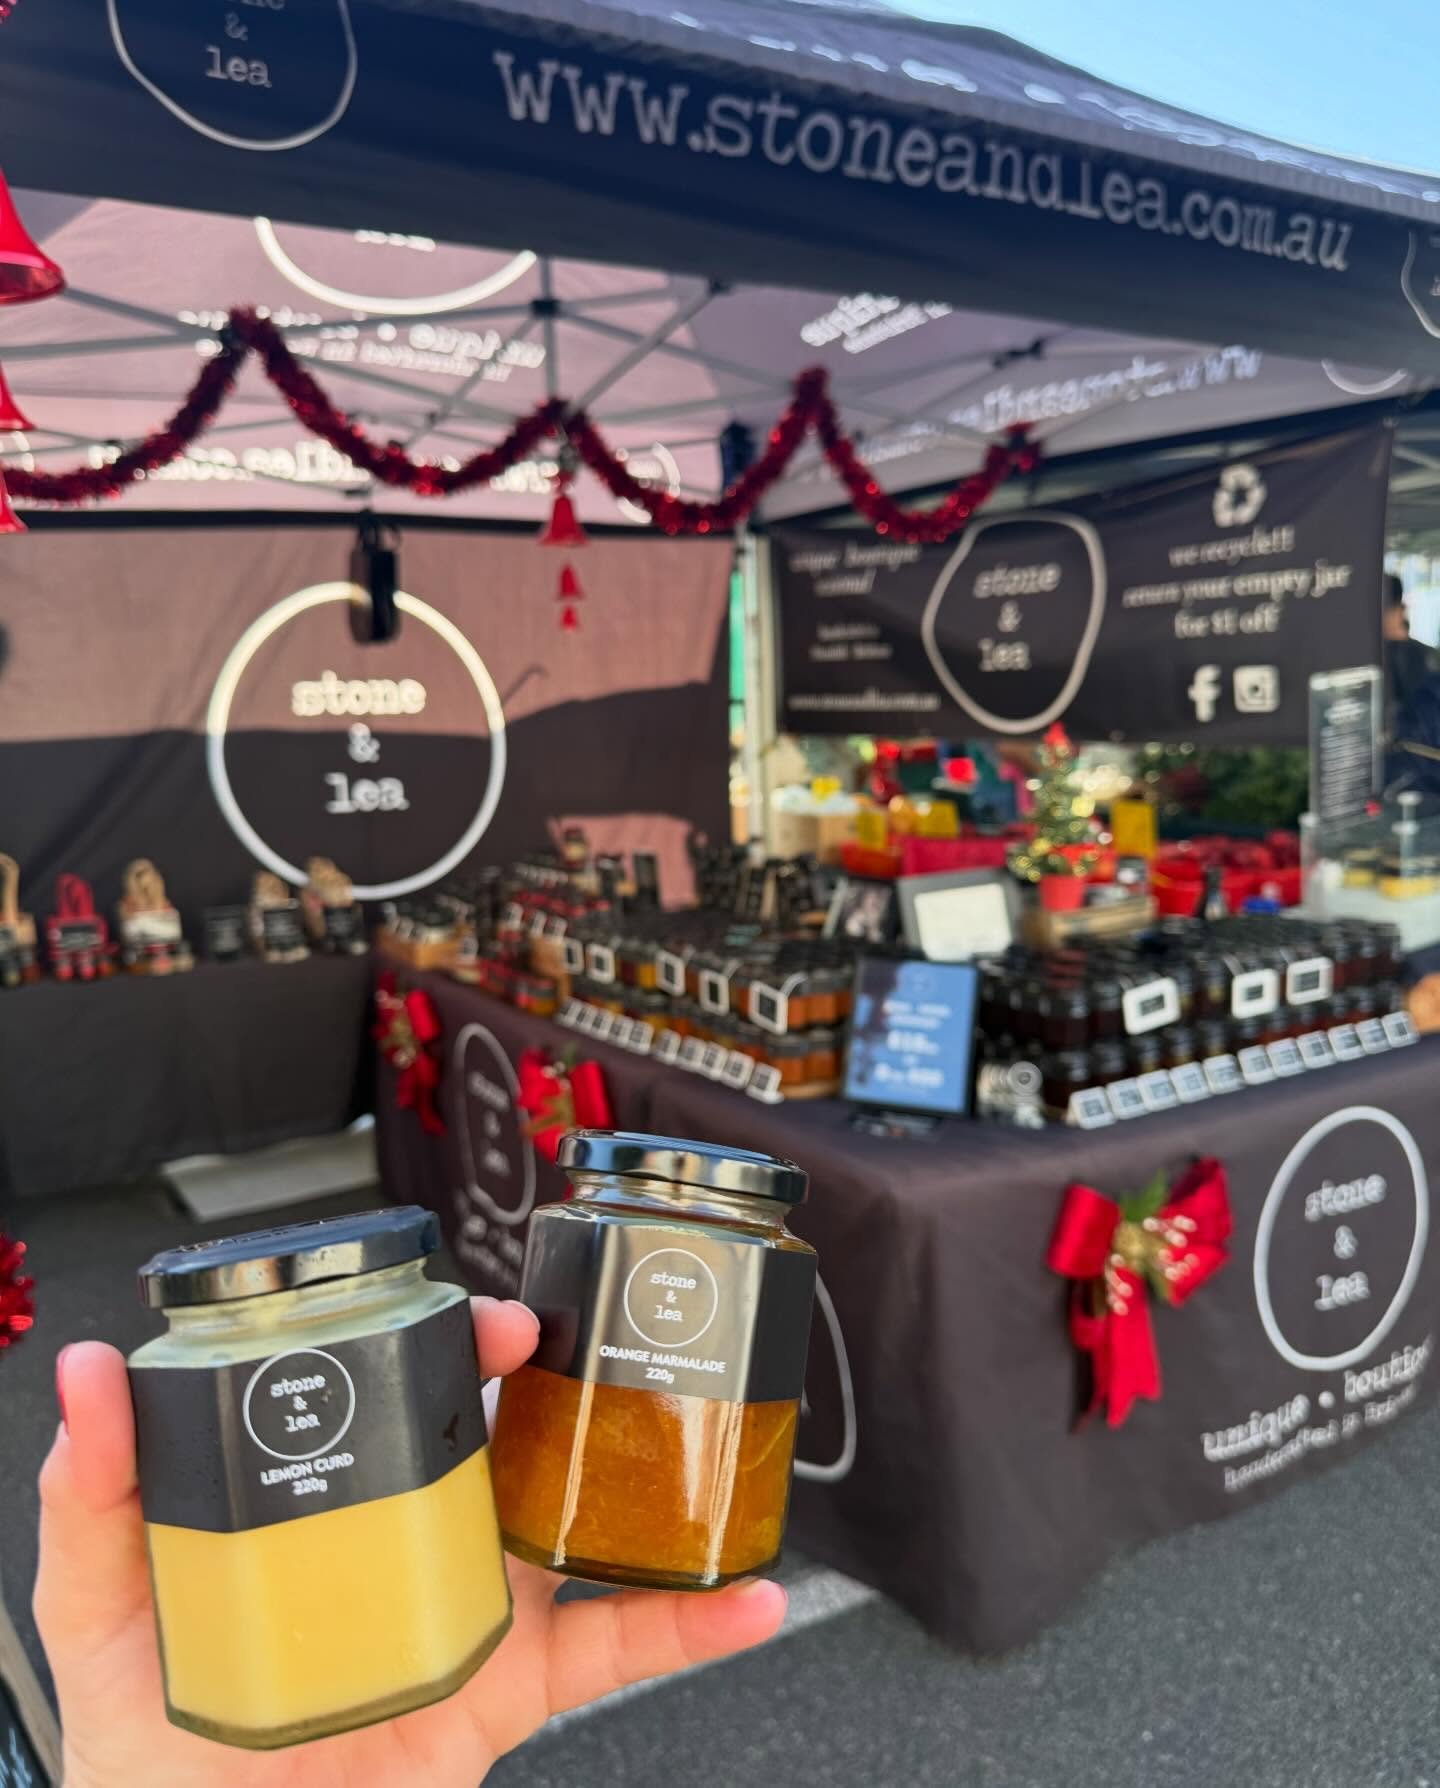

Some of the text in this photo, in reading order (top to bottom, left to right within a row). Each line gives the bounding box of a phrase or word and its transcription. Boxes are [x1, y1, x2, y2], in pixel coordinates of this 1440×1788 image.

[206, 46, 272, 88] lea
[493, 52, 1352, 272] www.stoneandlea.com.au
[973, 562, 1061, 598] stone
[1232, 567, 1313, 601] empty
[978, 637, 1031, 672] lea
[292, 669, 427, 716] stone
[348, 722, 380, 763] &
[324, 772, 409, 814] lea
[1305, 1173, 1387, 1222] stone
[650, 1271, 697, 1289] stone
[665, 1290, 677, 1303] &
[1314, 1271, 1371, 1311] lea
[654, 1305, 682, 1322] lea
[600, 1345, 726, 1373] ORANGE MARMALADE
[645, 1367, 675, 1384] 220g
[270, 1375, 326, 1398] stone
[293, 1396, 308, 1411] &
[284, 1414, 320, 1432] lea
[260, 1453, 354, 1485] LEMON CURD
[291, 1477, 328, 1496] 220g
